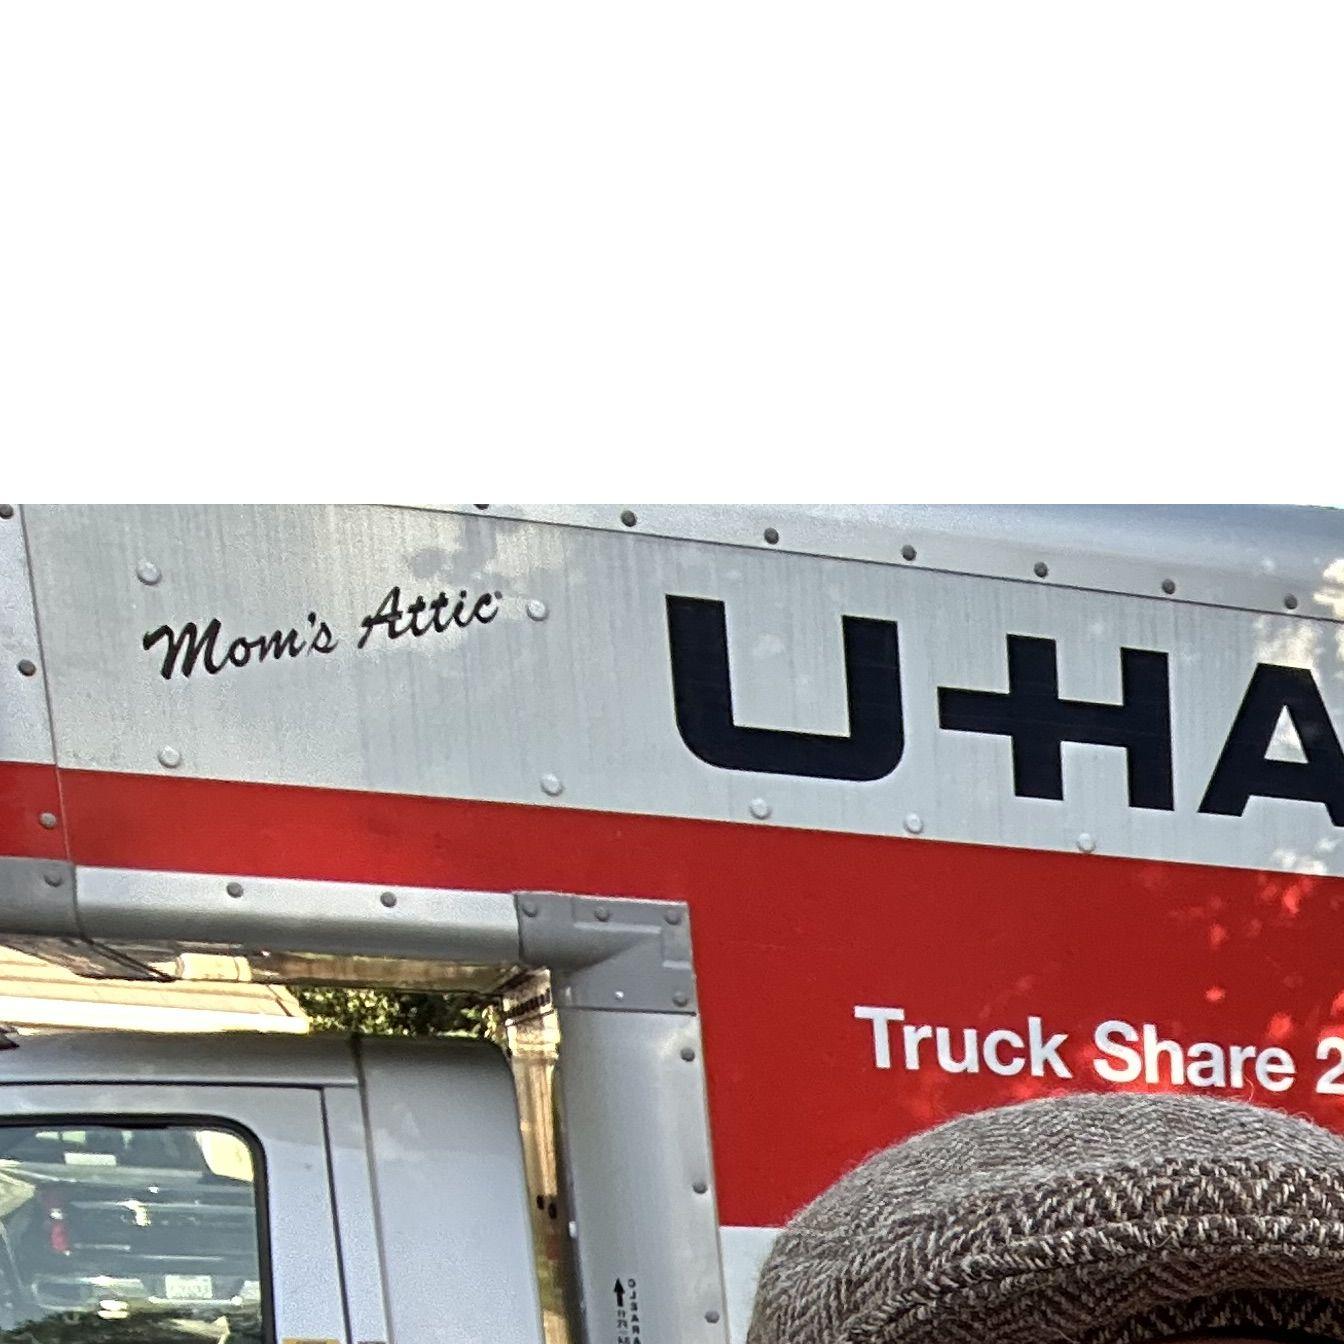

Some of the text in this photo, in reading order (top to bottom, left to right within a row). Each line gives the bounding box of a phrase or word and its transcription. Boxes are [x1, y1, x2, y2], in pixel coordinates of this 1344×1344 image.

[143, 586, 497, 680] Mom's Attic
[854, 1005, 1073, 1079] Truck
[1093, 1020, 1297, 1092] Share
